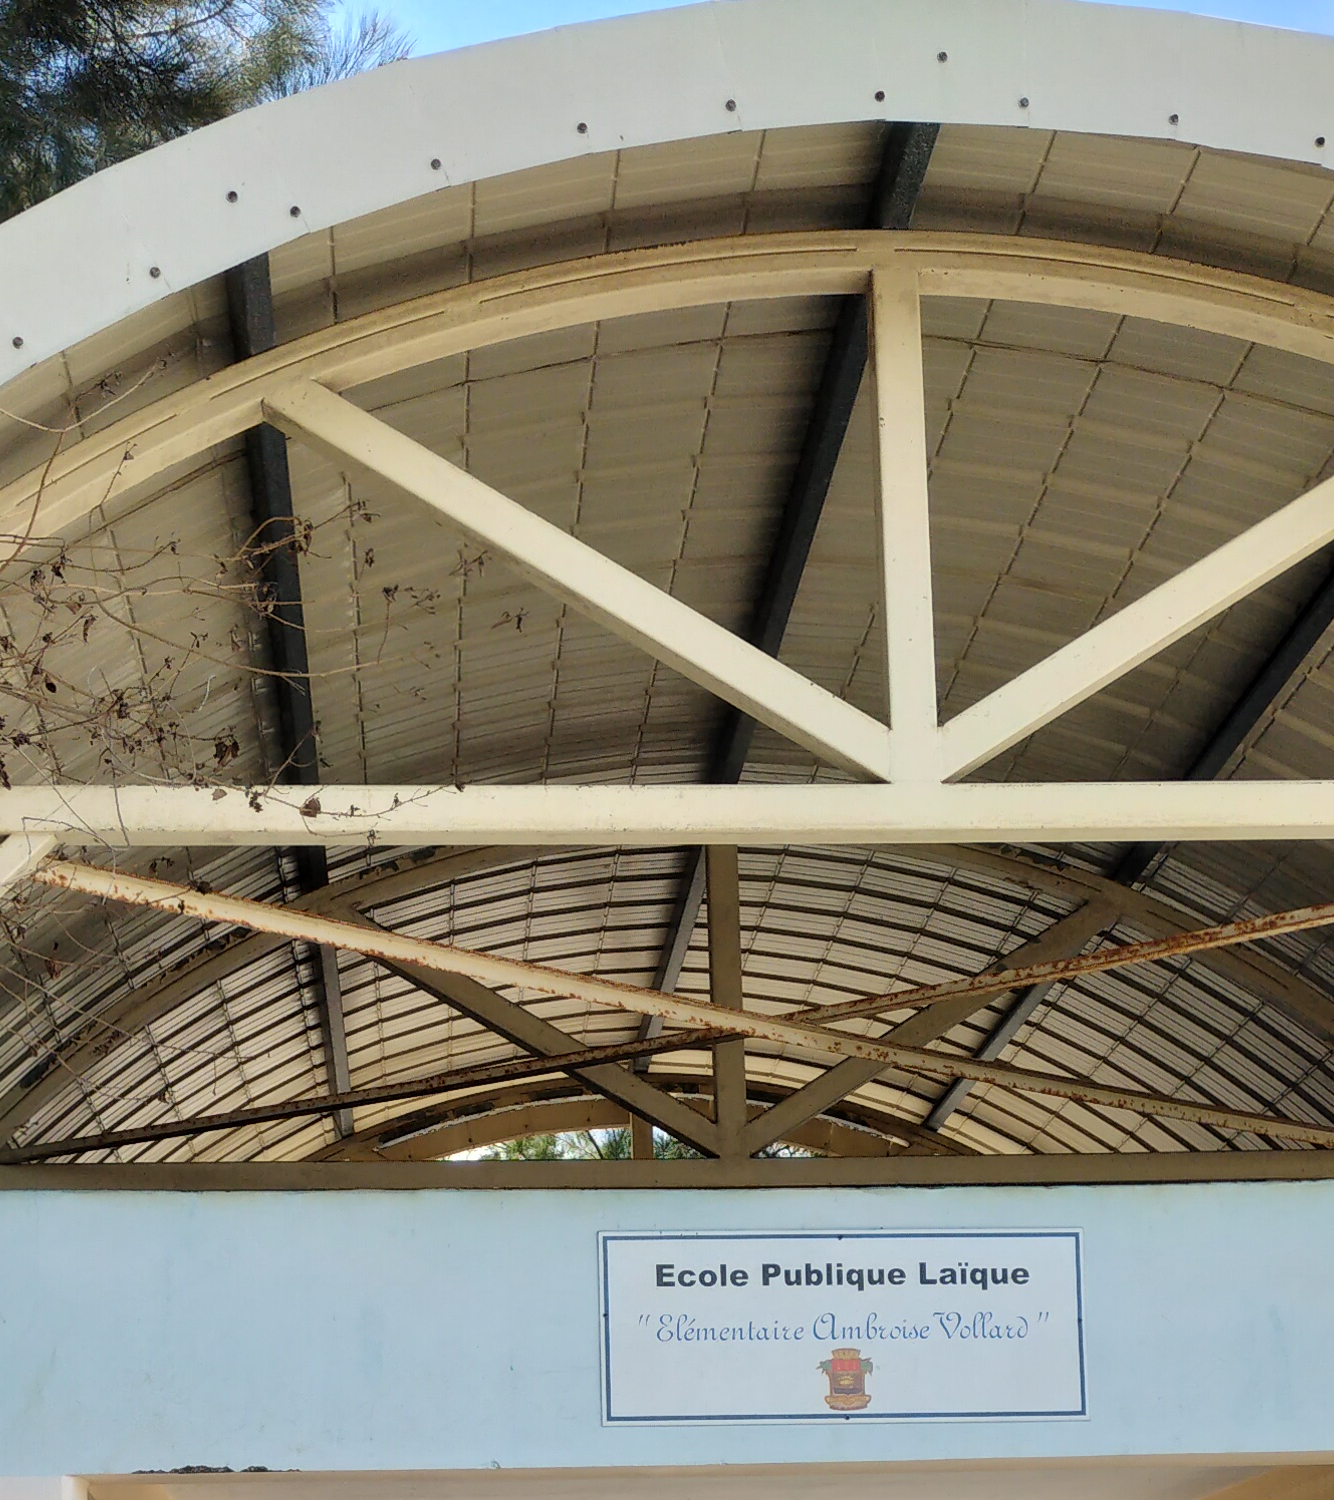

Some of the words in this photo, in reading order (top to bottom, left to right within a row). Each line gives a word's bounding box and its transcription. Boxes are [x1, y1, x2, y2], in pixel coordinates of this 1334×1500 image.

[655, 1263, 749, 1288] Ecole
[761, 1262, 907, 1292] Publique
[918, 1261, 1031, 1291] Laïque
[812, 1312, 931, 1342] Ambroise
